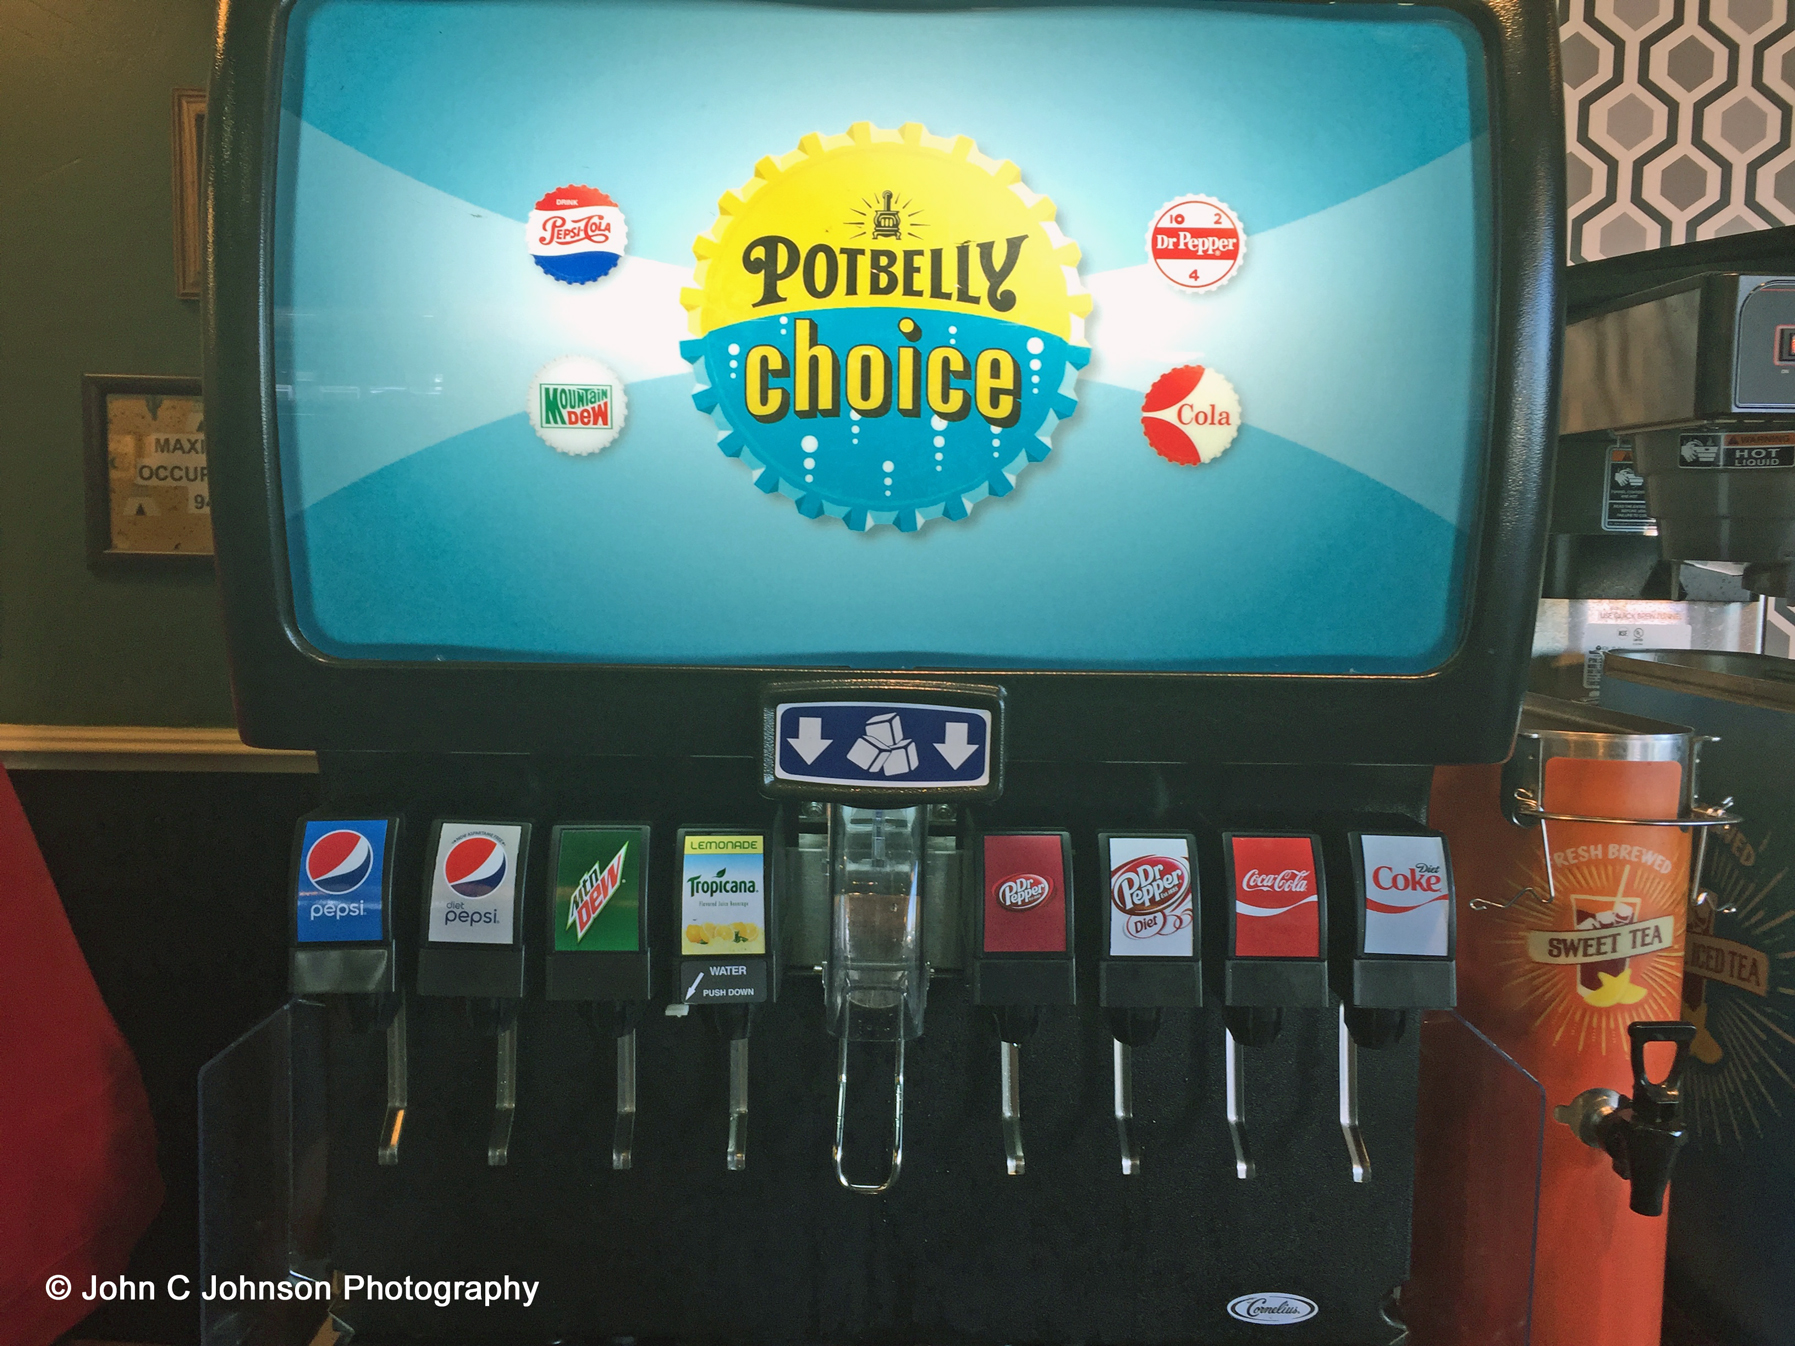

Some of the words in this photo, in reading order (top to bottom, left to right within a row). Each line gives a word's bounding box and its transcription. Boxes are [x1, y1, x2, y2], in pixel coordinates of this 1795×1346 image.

[555, 198, 579, 206] DRINK
[1169, 213, 1186, 225] 10
[1213, 212, 1223, 225] 2
[1155, 234, 1178, 250] Dr
[1177, 230, 1238, 256] Pepper
[742, 234, 1030, 313] POTBELLY
[1188, 268, 1200, 282] 4
[744, 316, 1023, 429] choice
[1176, 403, 1232, 426] Cola
[154, 437, 207, 455] MAXI
[1735, 448, 1780, 458] HOT
[1734, 458, 1780, 466] LIQUID
[690, 840, 758, 850] LEMONADE
[1415, 862, 1440, 874] Diet
[1607, 843, 1672, 874] BREWED
[1016, 877, 1034, 893] Dr
[1136, 864, 1164, 887] Dr
[1241, 868, 1310, 892] Coca-Cola
[1372, 865, 1442, 893] Coke
[687, 874, 757, 898] Tropicana
[999, 881, 1045, 906] Pepper
[1114, 869, 1182, 910] Pepper
[310, 899, 364, 920] pepsi
[446, 901, 465, 910] diet
[444, 908, 498, 927] pepsi
[1133, 915, 1158, 934] Diet
[1547, 932, 1621, 959] SWEET
[1628, 924, 1663, 950] TEA
[709, 965, 747, 976] WATER
[1727, 950, 1761, 987] TEA
[702, 989, 727, 997] PUSH
[727, 988, 755, 997] DOWN
